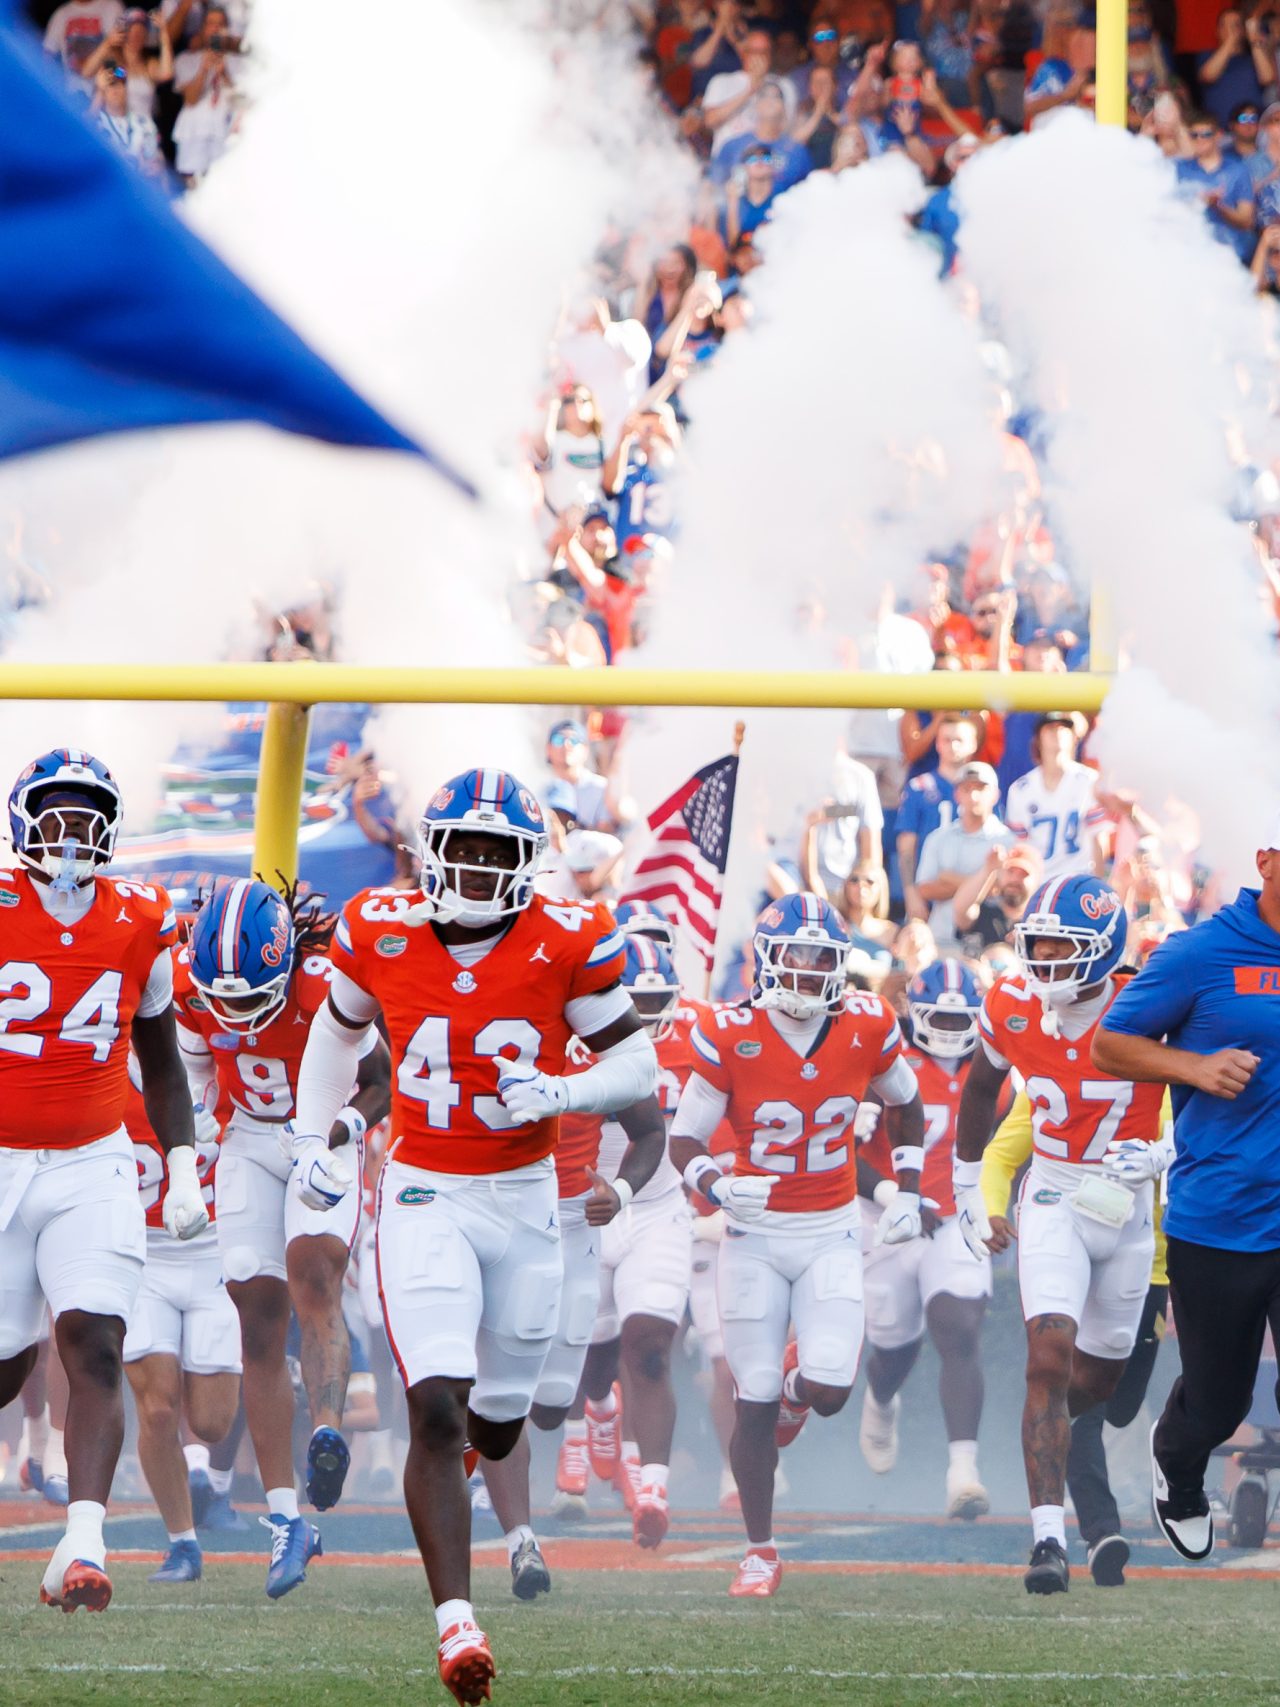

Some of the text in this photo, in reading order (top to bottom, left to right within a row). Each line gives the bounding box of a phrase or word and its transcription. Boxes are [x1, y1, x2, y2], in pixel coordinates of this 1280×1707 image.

[1080, 889, 1121, 920] Gat
[0, 960, 124, 1064] 24
[234, 1052, 296, 1118] 9
[396, 1015, 543, 1131] 43
[749, 1095, 859, 1175] 22
[1026, 1074, 1136, 1162] 27
